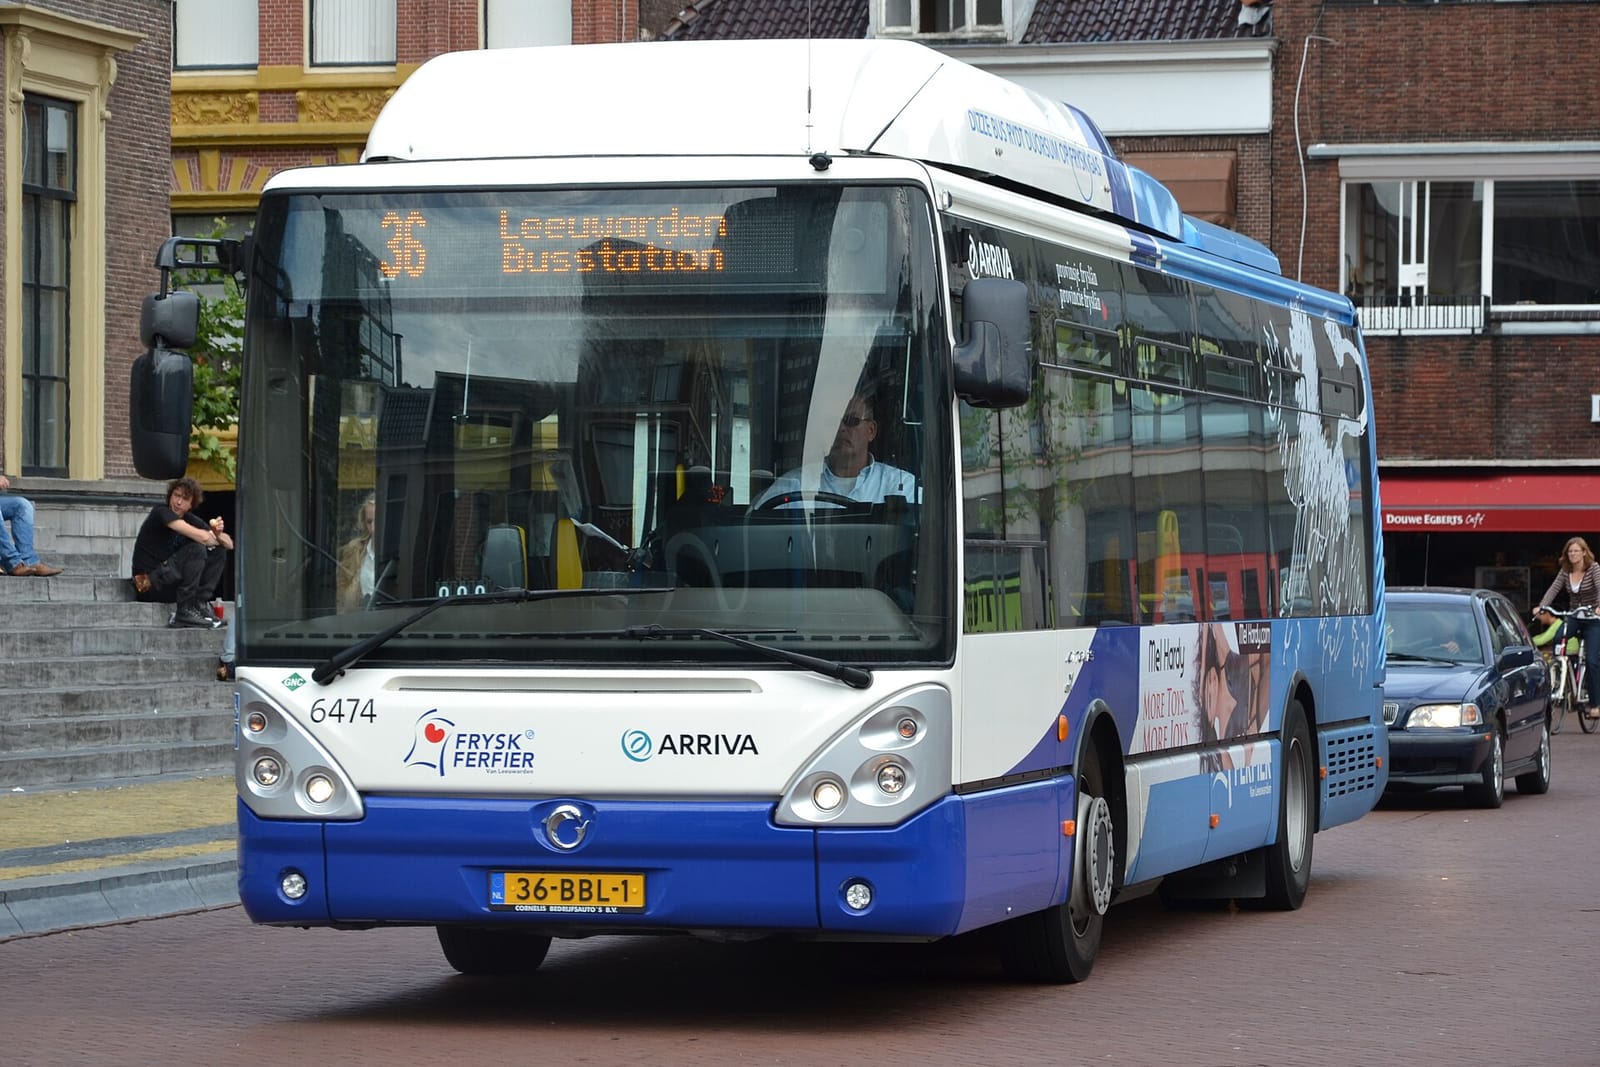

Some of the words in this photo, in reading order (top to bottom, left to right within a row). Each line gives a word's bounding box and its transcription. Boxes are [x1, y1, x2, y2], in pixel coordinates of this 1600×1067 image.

[991, 117, 1008, 142] BUS
[499, 207, 727, 240] Leeuwarden
[379, 210, 427, 278] 36
[502, 241, 725, 274] Busstation
[979, 241, 1014, 280] ARRIVA
[284, 677, 304, 686] GNC
[310, 698, 377, 724] 6474
[1143, 691, 1165, 721] MORE
[455, 733, 522, 750] FRYSK
[658, 734, 759, 755] ARRIVA
[1143, 724, 1168, 752] MORE
[453, 751, 534, 768] FERFIER
[492, 891, 503, 900] NL
[516, 877, 629, 903] 36-BBL-1
